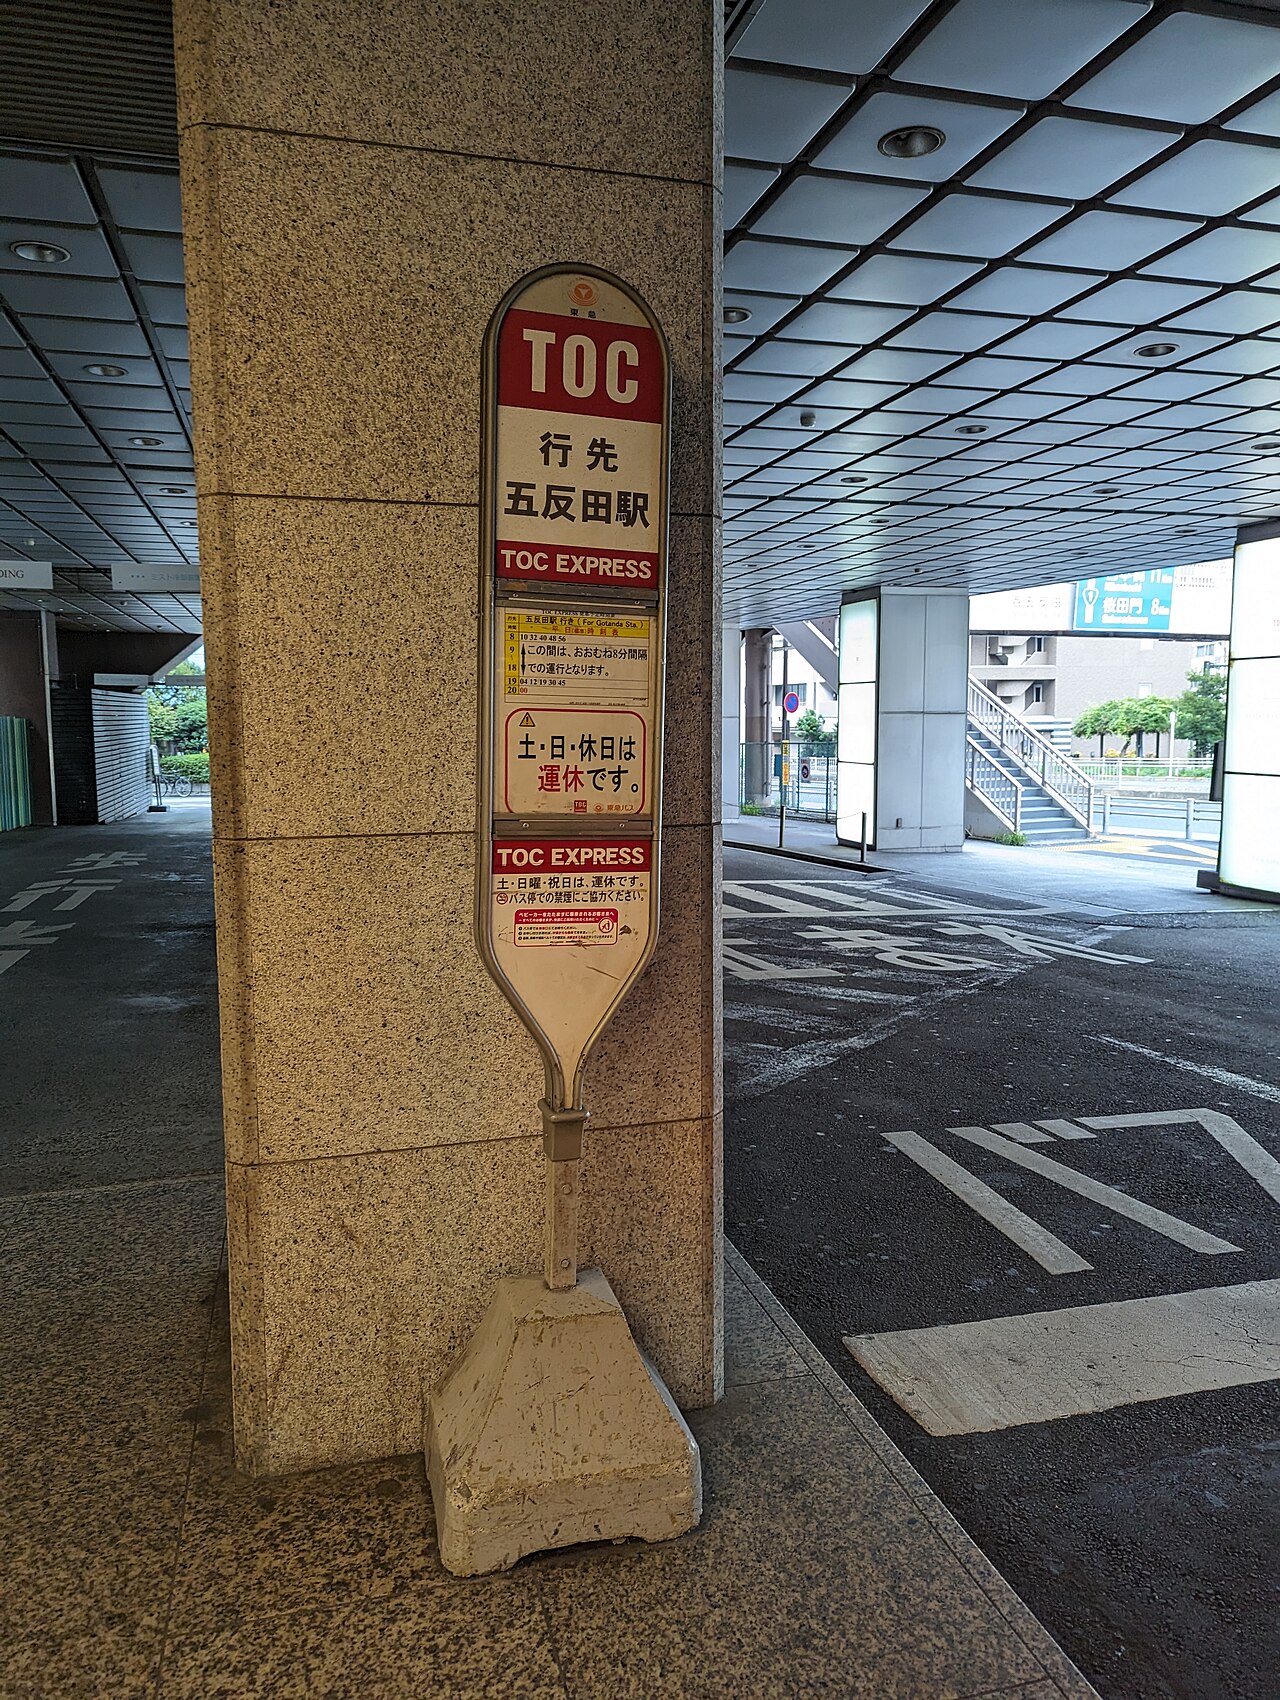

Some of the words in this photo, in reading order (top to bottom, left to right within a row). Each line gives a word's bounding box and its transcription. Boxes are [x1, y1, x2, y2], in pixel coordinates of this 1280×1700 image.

[570, 308, 597, 319] 東急
[523, 328, 640, 404] TOC
[539, 431, 619, 473] 行先
[504, 481, 651, 529] 五反田駅
[500, 549, 549, 572] TOC
[555, 553, 652, 580] EXPRESS
[509, 646, 515, 654] 9
[527, 646, 648, 660] この間は、おおむね8分間隔
[508, 663, 517, 672] 18
[528, 663, 609, 677] での運行となります。
[508, 677, 517, 685] 19
[507, 686, 517, 694] 20
[517, 733, 637, 762] 土・日・休日は
[537, 764, 639, 793] 運休です。
[497, 848, 544, 866] TOC
[551, 847, 645, 866] EXPRESS
[496, 875, 644, 890] 土・日曜・祝日は、運休です。
[508, 891, 645, 905] バス停での禁煙にご協力ください。
